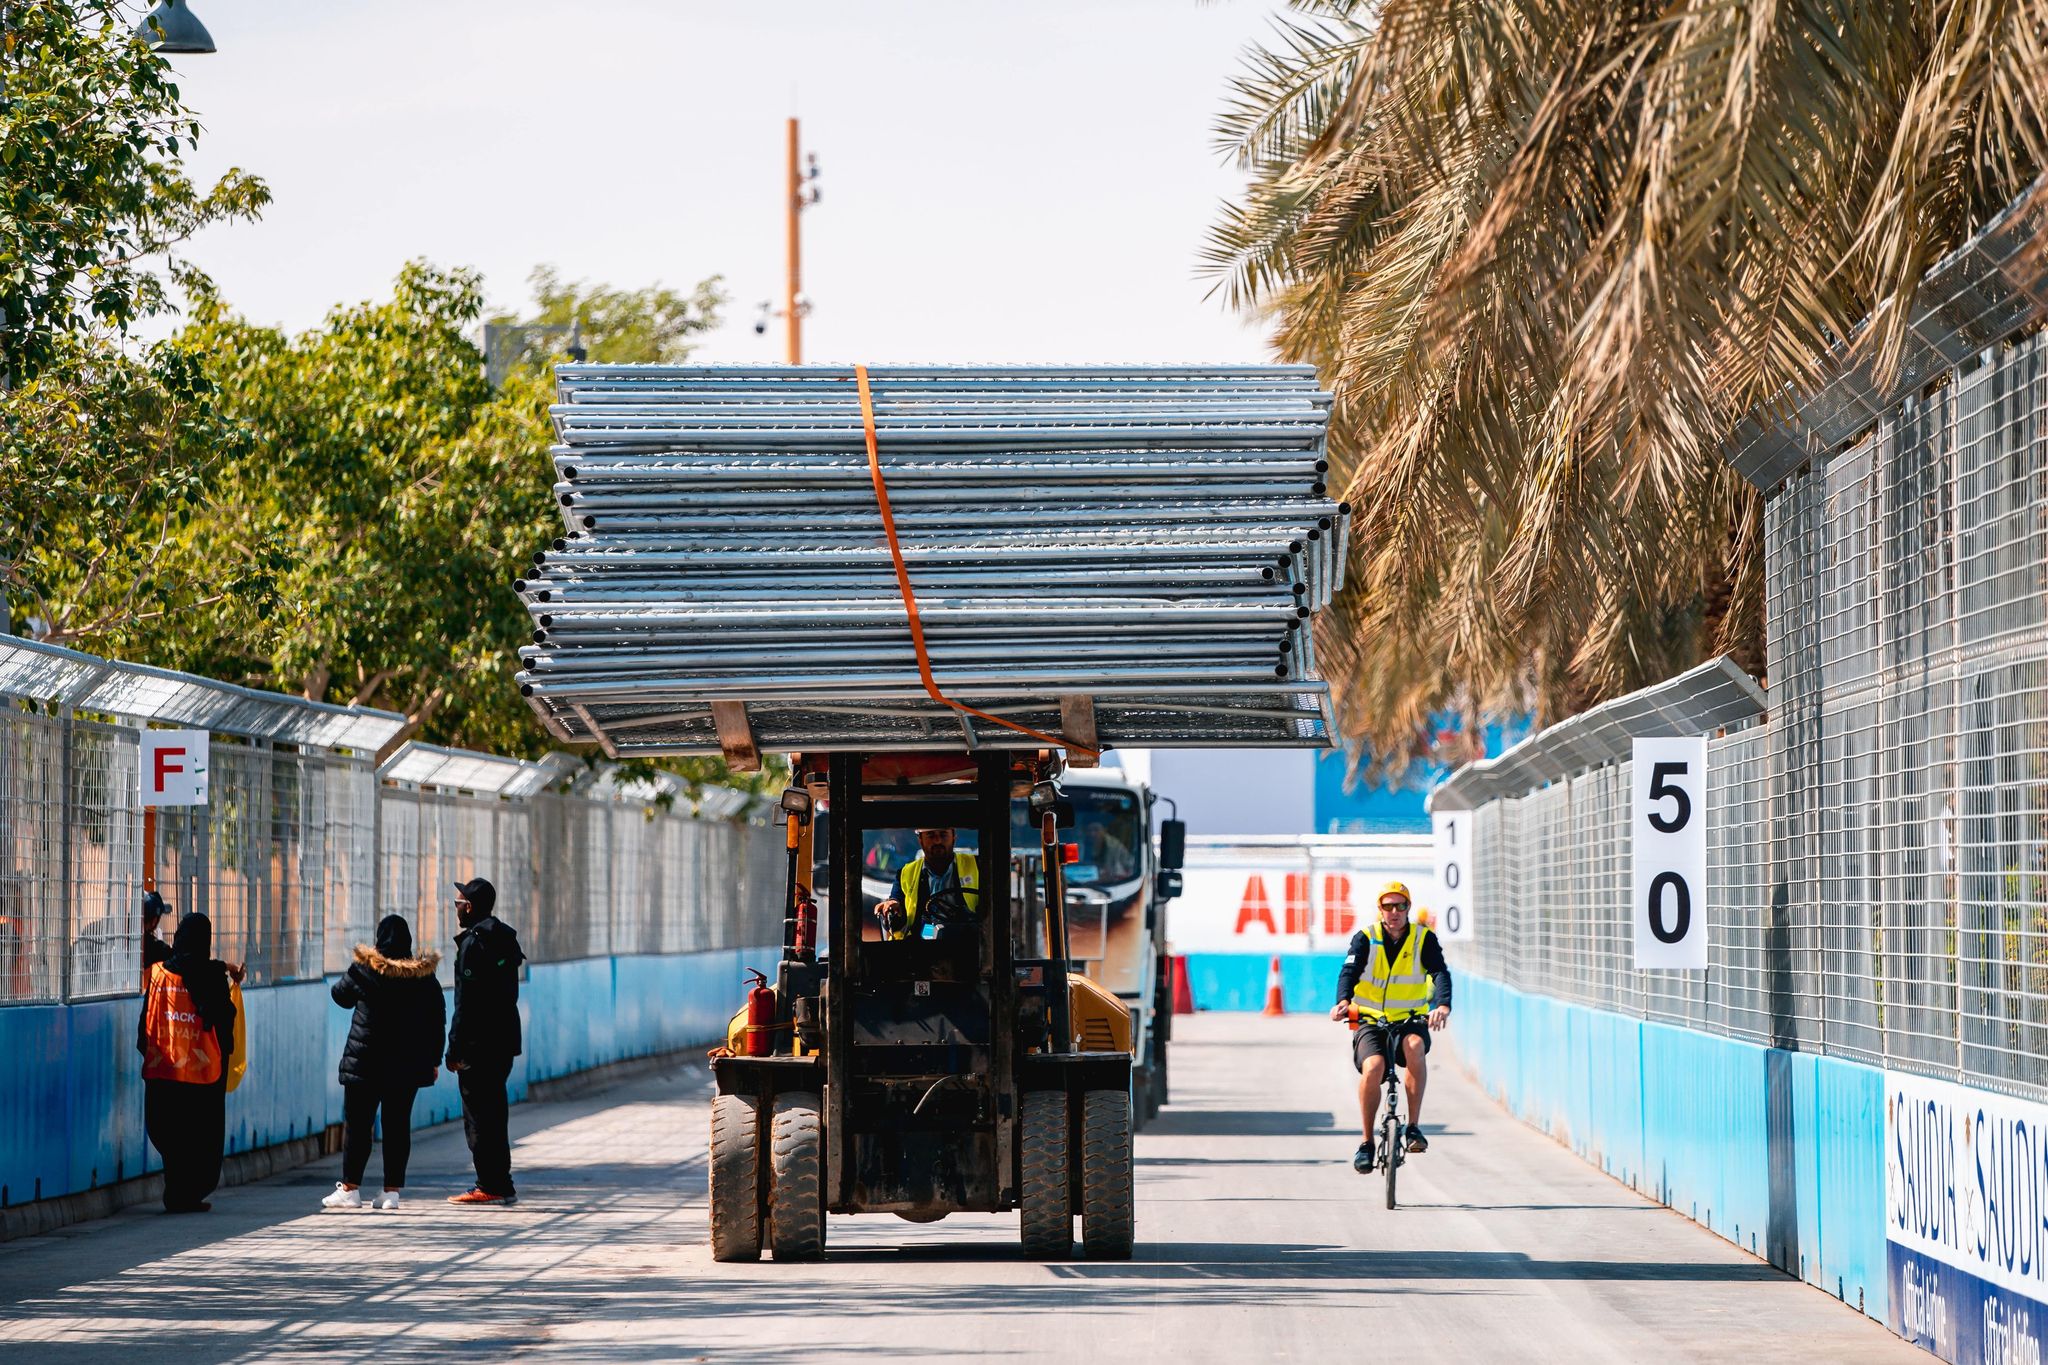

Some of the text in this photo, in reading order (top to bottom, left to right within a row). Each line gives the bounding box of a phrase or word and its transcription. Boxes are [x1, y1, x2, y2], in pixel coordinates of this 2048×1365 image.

[154, 747, 186, 792] F
[1235, 873, 1357, 935] ABB
[1897, 1091, 1958, 1249] SAUDIA
[1903, 1260, 1947, 1347] Official Airline
